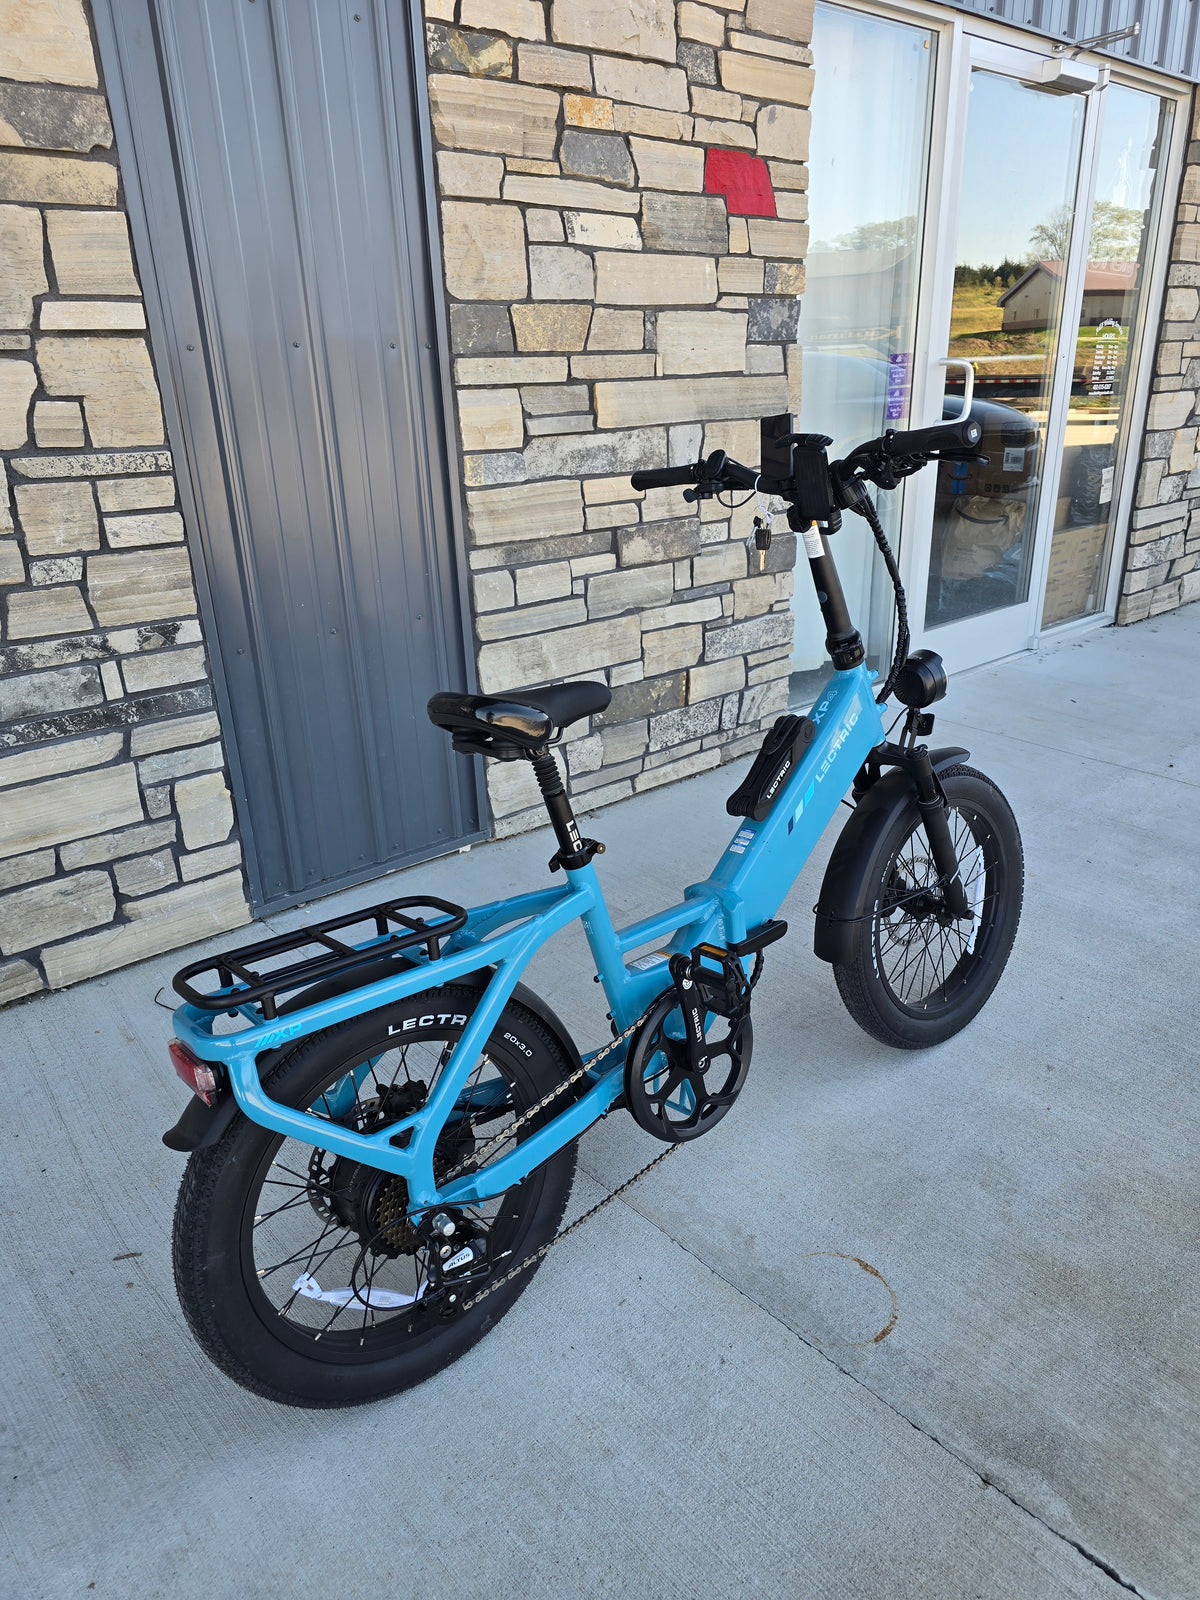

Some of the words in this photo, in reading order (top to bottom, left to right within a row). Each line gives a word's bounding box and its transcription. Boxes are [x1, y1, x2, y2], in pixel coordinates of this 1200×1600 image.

[815, 712, 859, 783] LECTRIC
[766, 759, 792, 799] LECTRIC
[387, 1013, 471, 1036] LECTR
[691, 1006, 704, 1043] LECTRIC
[503, 1032, 533, 1058] 20x3.0
[448, 1252, 470, 1269] ALTUS
